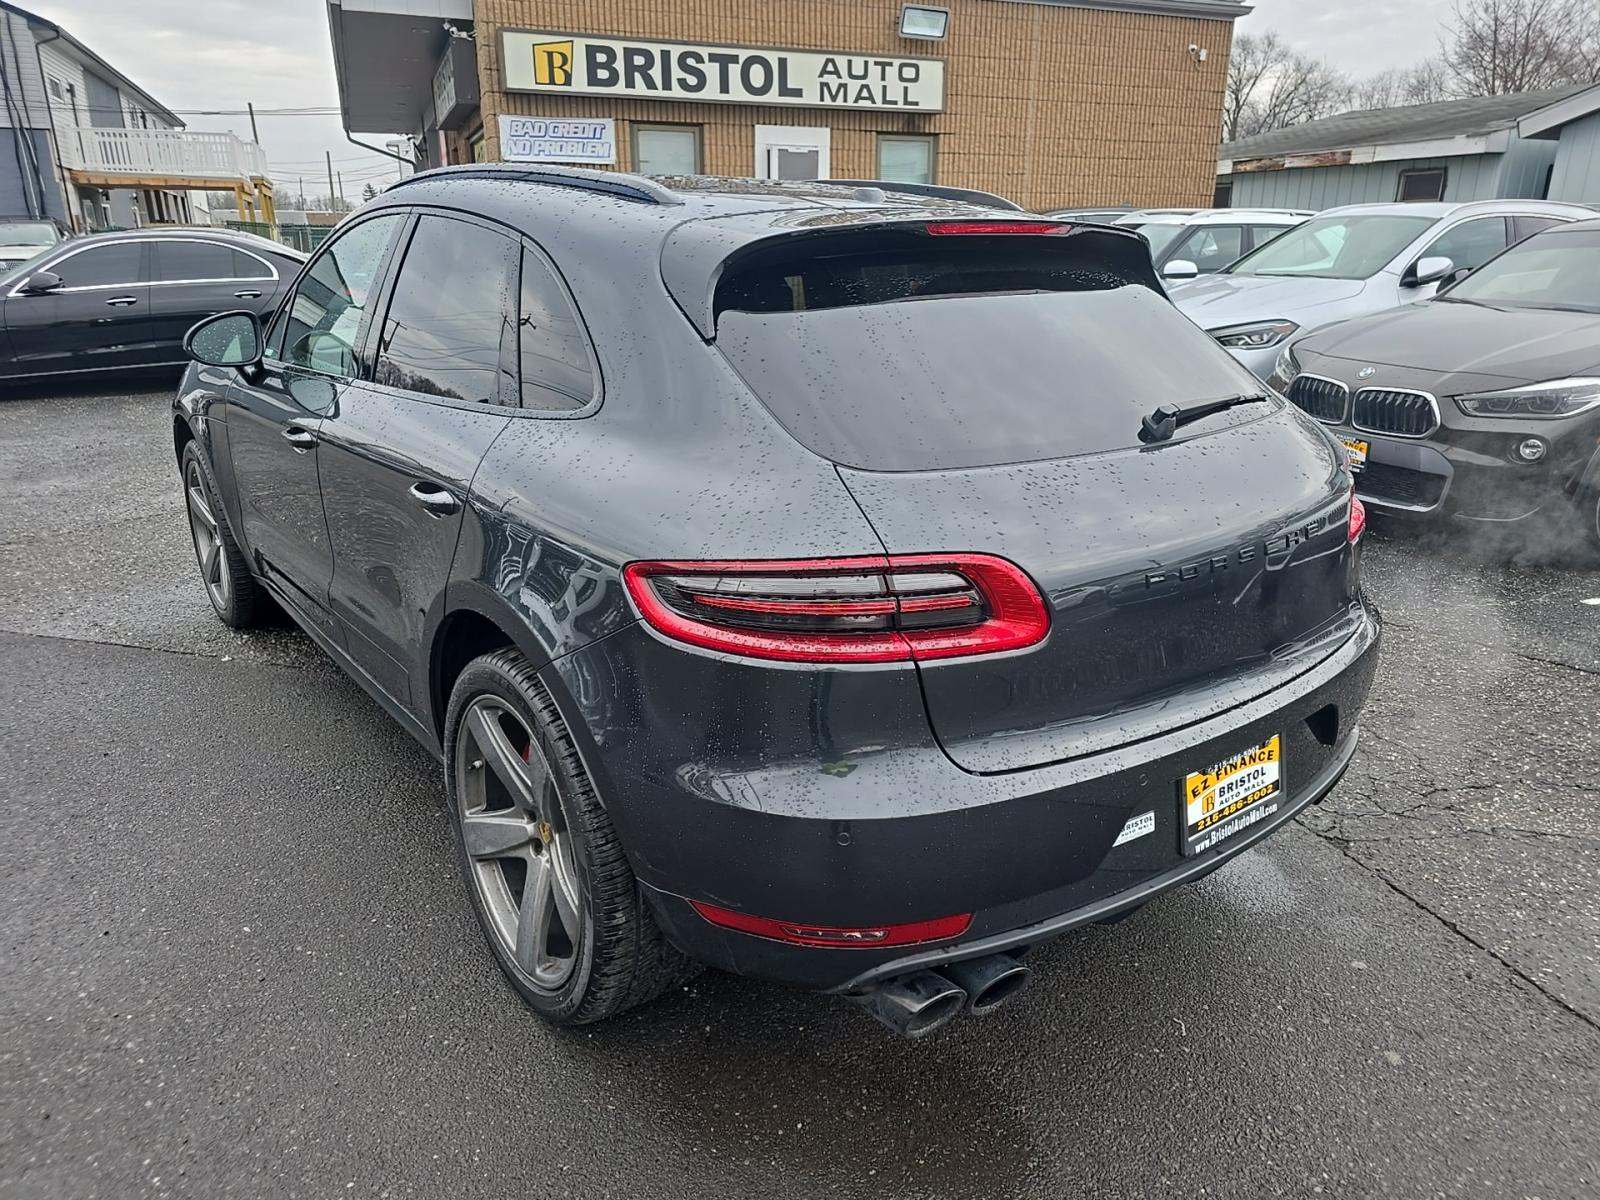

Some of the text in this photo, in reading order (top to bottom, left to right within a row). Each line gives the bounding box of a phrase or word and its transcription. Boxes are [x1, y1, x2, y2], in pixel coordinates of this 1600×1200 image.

[584, 43, 804, 99] BRISTOL
[817, 57, 921, 83] AUTO
[818, 82, 921, 107] MALL
[510, 120, 606, 140] BAD CREDIT
[507, 139, 611, 158] NO PROBLEM
[1145, 522, 1320, 590] PORSCHE
[1191, 749, 1274, 799] EZ FINANCE
[1218, 766, 1267, 798] BRISTOL
[1197, 784, 1274, 831] 215-486-5002
[1218, 780, 1265, 807] AUTO MALL
[1194, 803, 1278, 854] www.BristolAutoMall.com
